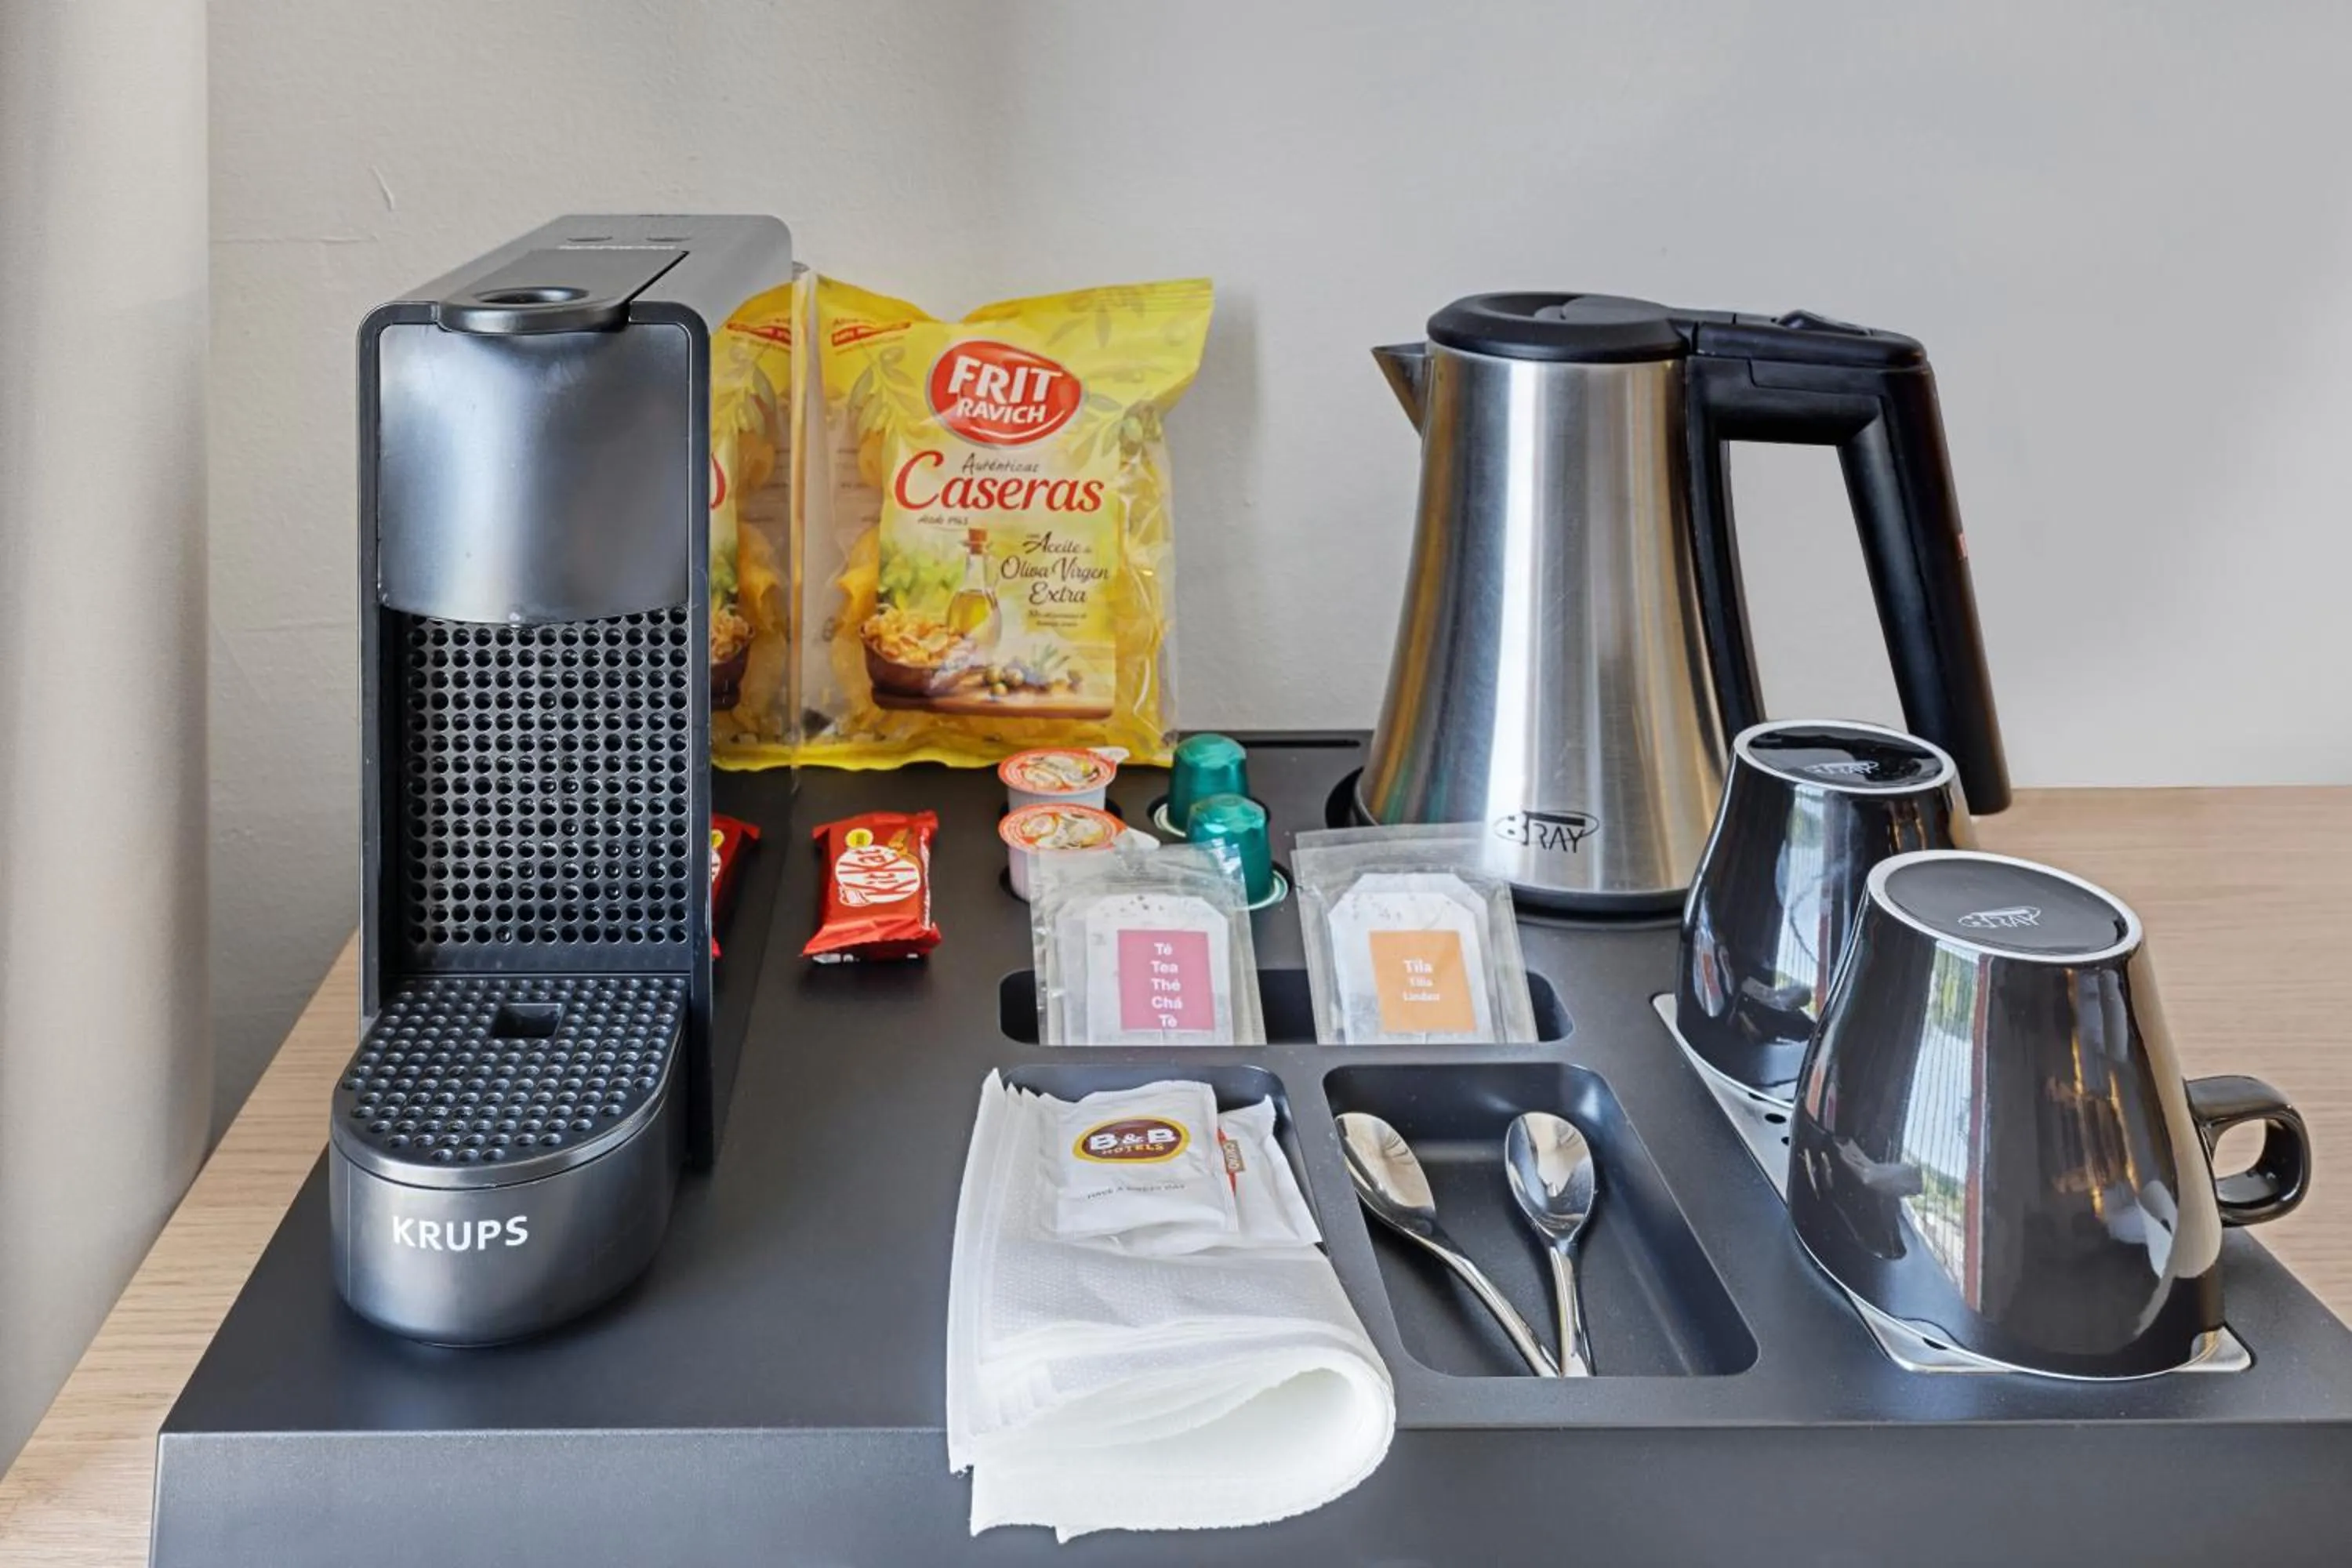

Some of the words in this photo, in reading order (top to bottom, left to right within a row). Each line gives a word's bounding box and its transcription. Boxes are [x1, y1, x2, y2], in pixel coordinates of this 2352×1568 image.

[948, 355, 1062, 404] FRIT
[956, 397, 1046, 423] RAVICH
[895, 450, 1105, 512] Caseras
[1022, 531, 1080, 554] Aceite
[1000, 555, 1048, 579] Oliva
[1051, 556, 1109, 583] Virgen
[1028, 581, 1087, 605] Extra
[1150, 960, 1178, 974] Tea
[1090, 1128, 1176, 1150] B&B
[1102, 1143, 1164, 1155] HOTELS
[392, 1215, 528, 1251] KRUPS
